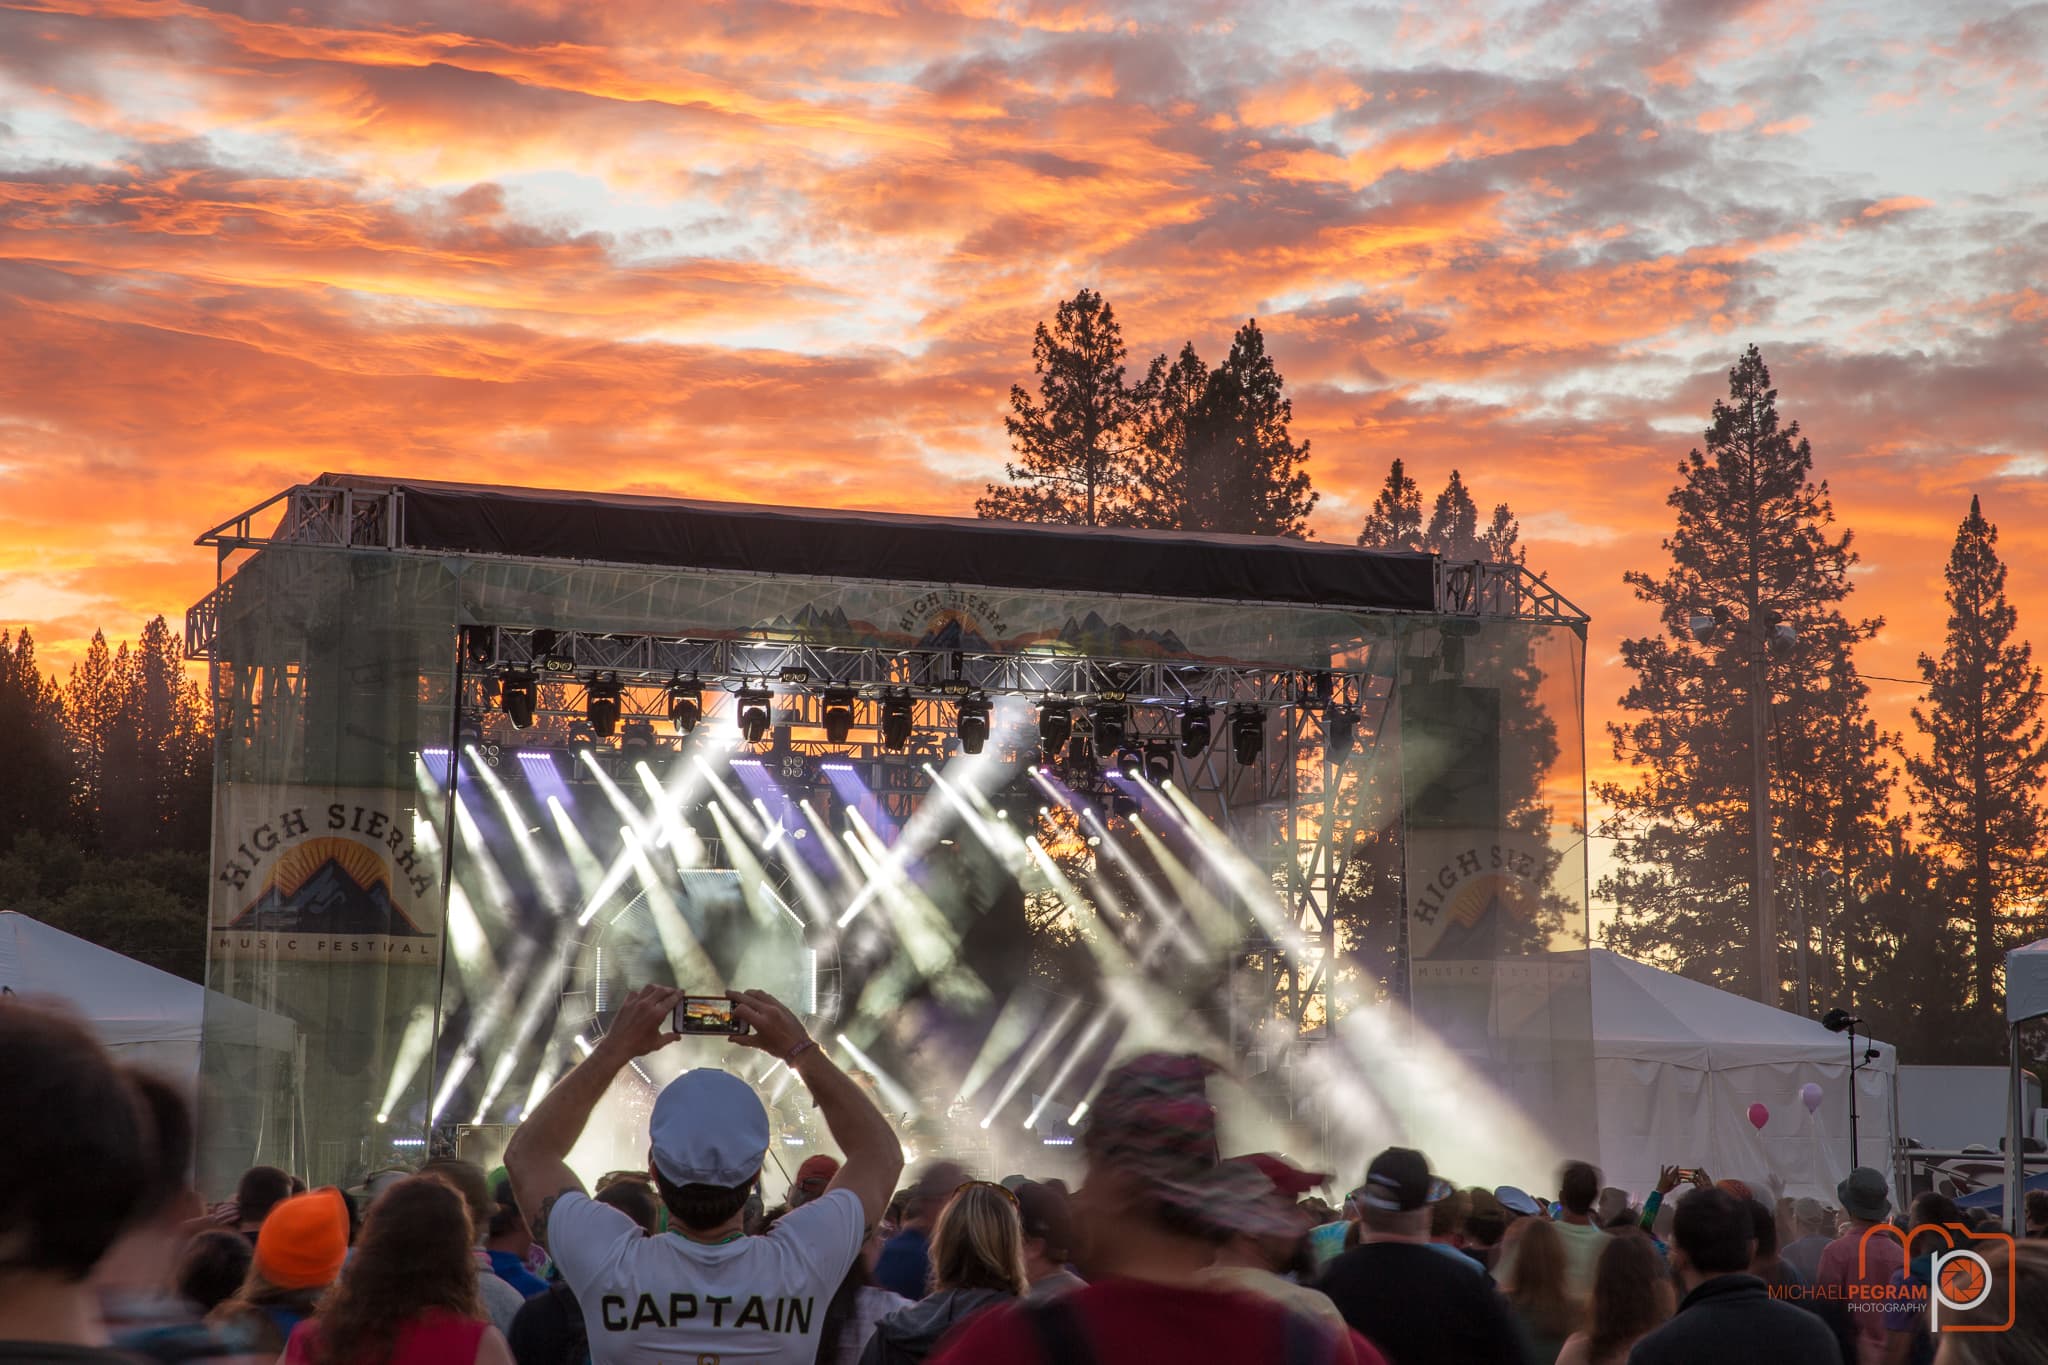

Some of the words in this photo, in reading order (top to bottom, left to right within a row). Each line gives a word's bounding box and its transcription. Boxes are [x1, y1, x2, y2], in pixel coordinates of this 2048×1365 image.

[899, 591, 940, 632] HIGH
[949, 589, 1007, 636] SIERRA
[220, 808, 310, 892] HIGH
[327, 803, 434, 898] SIERRA
[1414, 849, 1482, 926] HIGH
[220, 937, 297, 951] MUSIC
[317, 940, 428, 955] FESTIVAL
[601, 1292, 814, 1335] CAPTAIN
